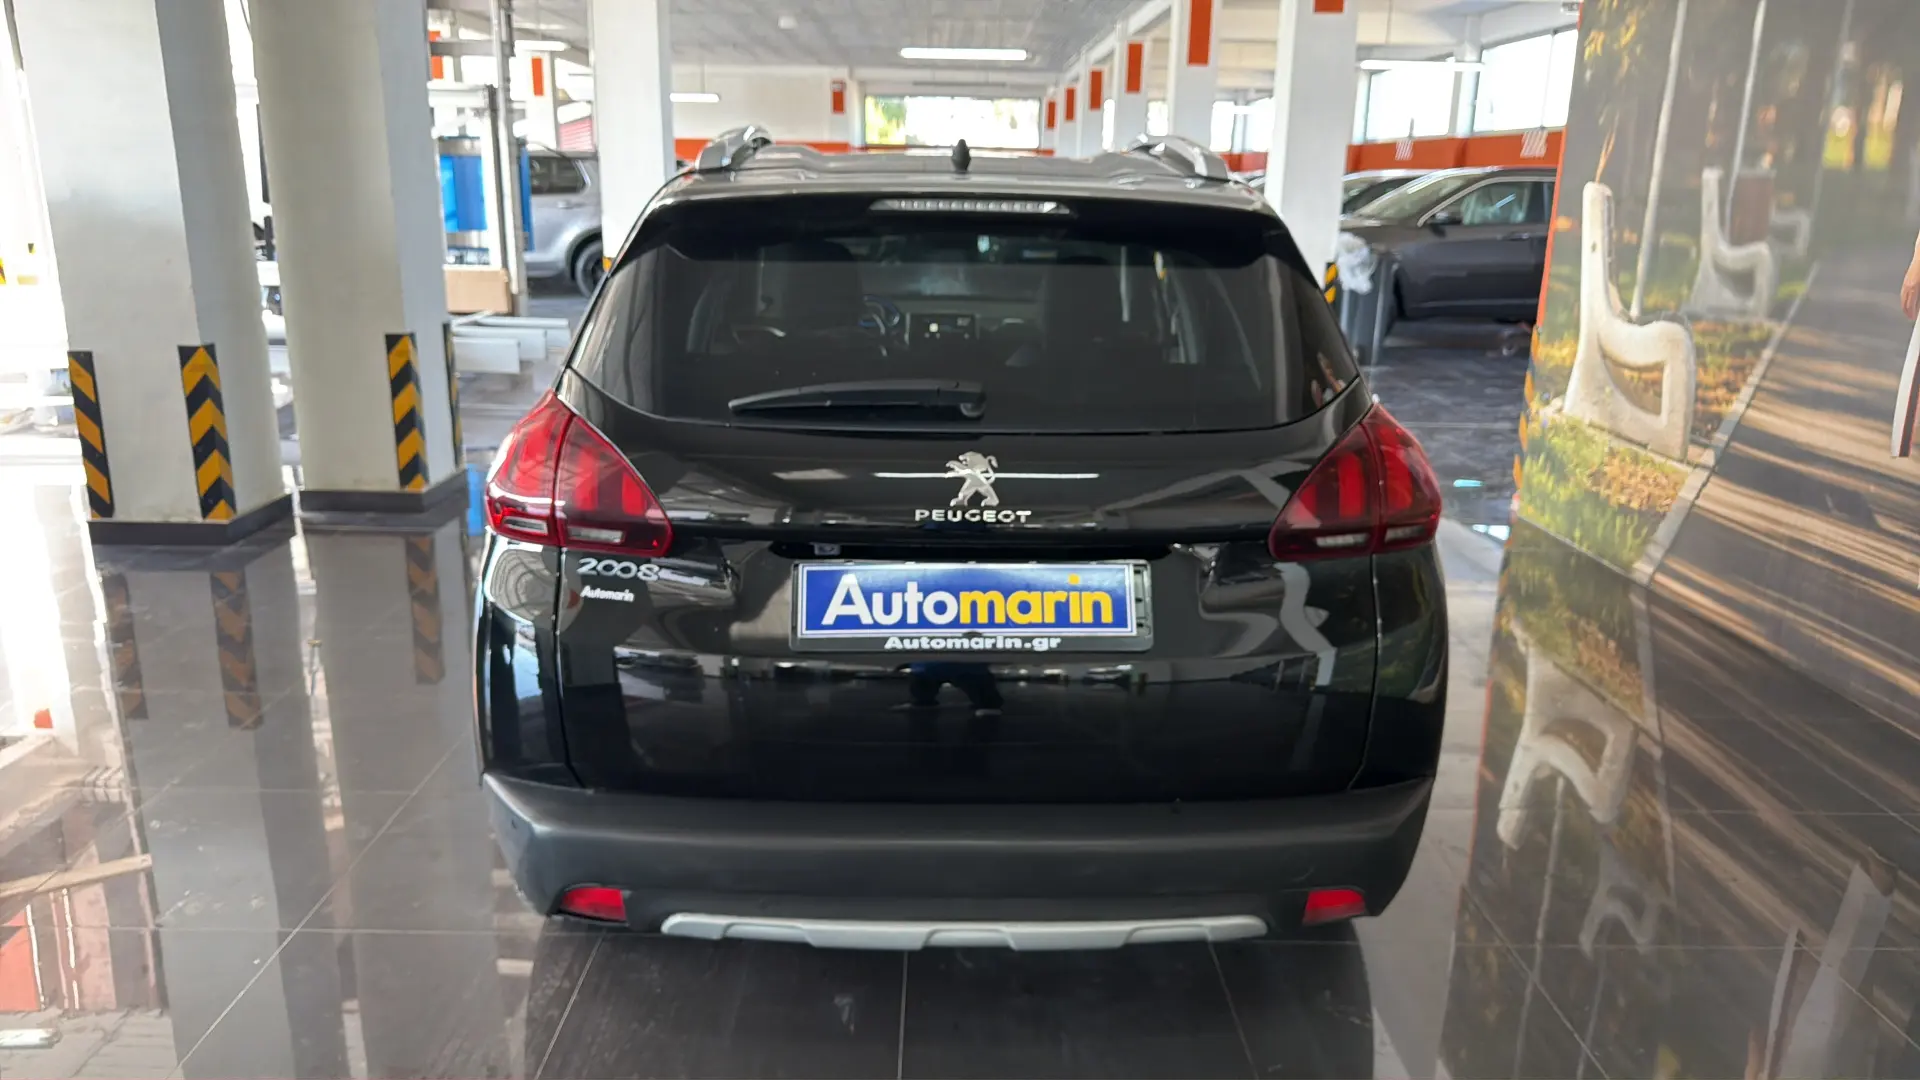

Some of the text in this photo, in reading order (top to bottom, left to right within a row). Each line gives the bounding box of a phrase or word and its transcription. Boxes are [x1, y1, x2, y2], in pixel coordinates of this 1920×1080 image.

[915, 508, 1032, 523] PEUGEOT
[577, 557, 660, 581] 2008
[581, 586, 635, 602] Automarin
[821, 573, 1113, 625] Automarin
[884, 635, 1062, 651] Automarin.gr
